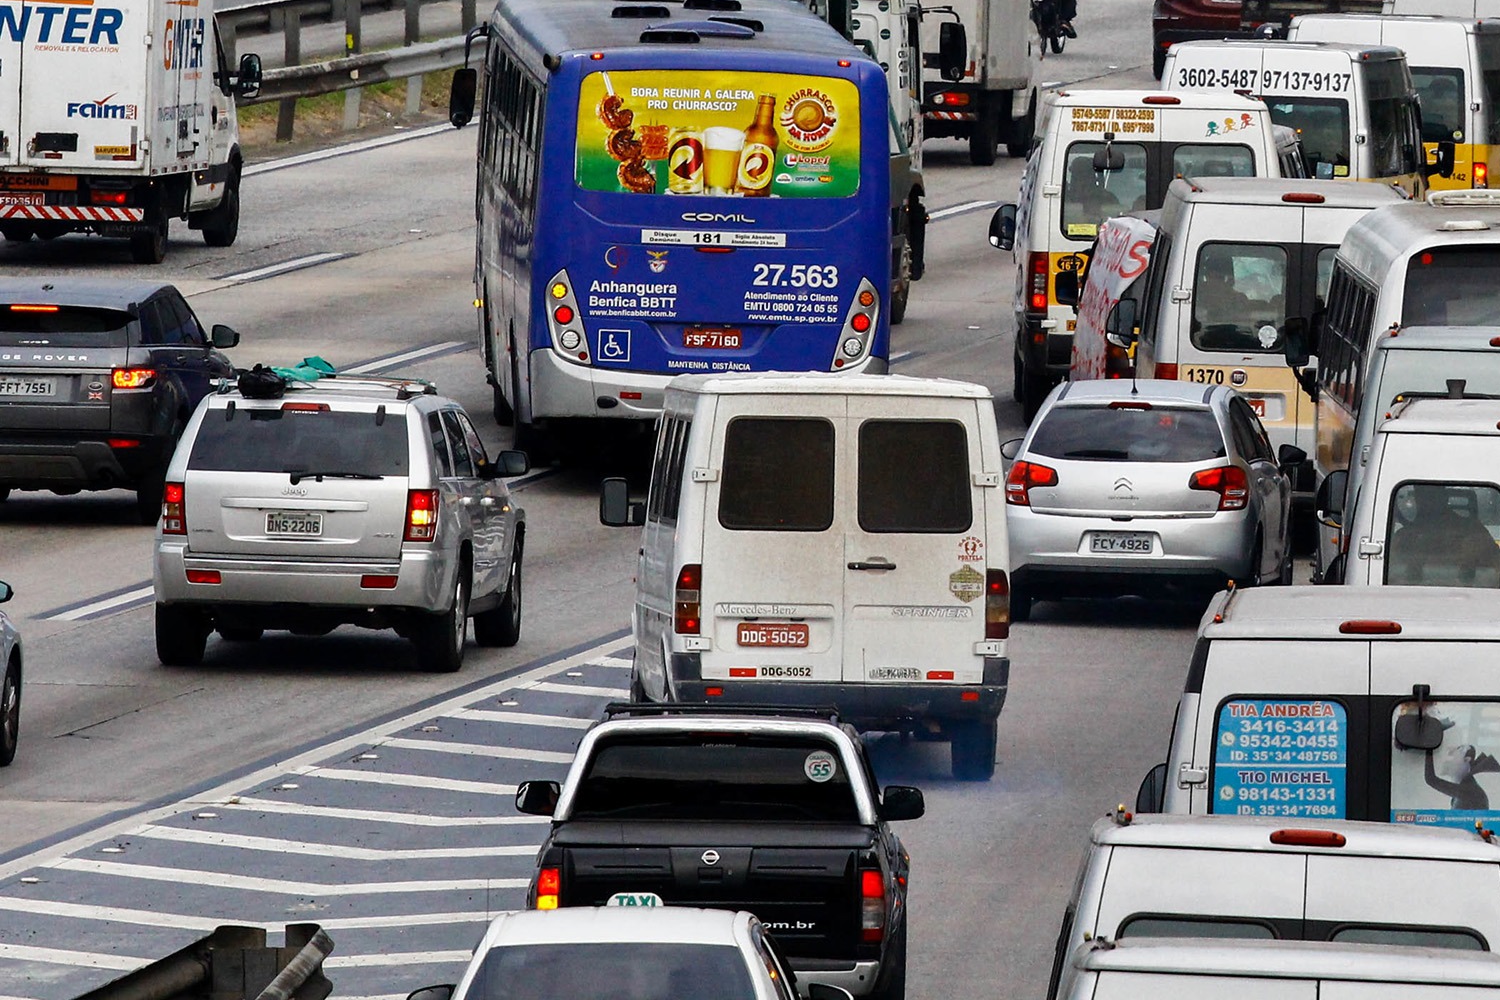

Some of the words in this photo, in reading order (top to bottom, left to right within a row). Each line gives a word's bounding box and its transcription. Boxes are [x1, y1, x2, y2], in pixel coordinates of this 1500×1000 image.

[34, 44, 70, 52] REMOVALS
[1179, 68, 1258, 88] 3602-5487
[1263, 71, 1351, 92] 97137-9137
[631, 87, 659, 98] BORA
[663, 88, 700, 98] REUNIR
[704, 88, 712, 98] A
[715, 89, 755, 100] GALERA
[647, 100, 668, 109] PRO
[672, 100, 738, 111] CHURRASCO?
[783, 88, 835, 113] CHURRASCO
[125, 104, 134, 120] PLUS
[798, 154, 831, 165] Lopes
[681, 212, 755, 223] COMIL
[692, 233, 721, 243] 181
[752, 263, 839, 288] 27.563
[589, 280, 677, 296] Anhanguera
[589, 295, 637, 307] Benfica
[640, 297, 676, 308] BBTT
[744, 291, 796, 301] Atendimento
[809, 293, 839, 302] Cliente
[589, 309, 677, 317] www.benficabbtt.com.br
[744, 302, 771, 311] EMTU
[772, 303, 794, 312] 0800
[796, 303, 812, 312] 724
[814, 304, 825, 313] 05
[827, 304, 838, 313] 55
[33, 354, 88, 362] ROVER
[668, 360, 708, 370] MANTENHA
[712, 361, 751, 371] DISTÂNCIA
[1187, 368, 1224, 385] 1370
[281, 487, 308, 496] Jeep
[1092, 538, 1150, 551] FCY-4926
[720, 604, 797, 616] Mercedes-Benz
[891, 607, 969, 618] SPRINTER
[741, 630, 806, 644] DDG-5052
[761, 667, 811, 677] DDG-5052
[1229, 703, 1258, 717] TIA
[1262, 702, 1335, 717] ANDRÉA
[1240, 720, 1338, 733] 3416-3414
[1239, 734, 1338, 748] 95342-0455
[1230, 751, 1248, 761] ID:
[811, 764, 830, 777] 55
[1239, 771, 1266, 784] TIO
[1271, 771, 1332, 784] MICHEL
[1238, 787, 1336, 801] 98143-1331
[1237, 805, 1255, 815] ID:
[615, 895, 656, 907] TAXI
